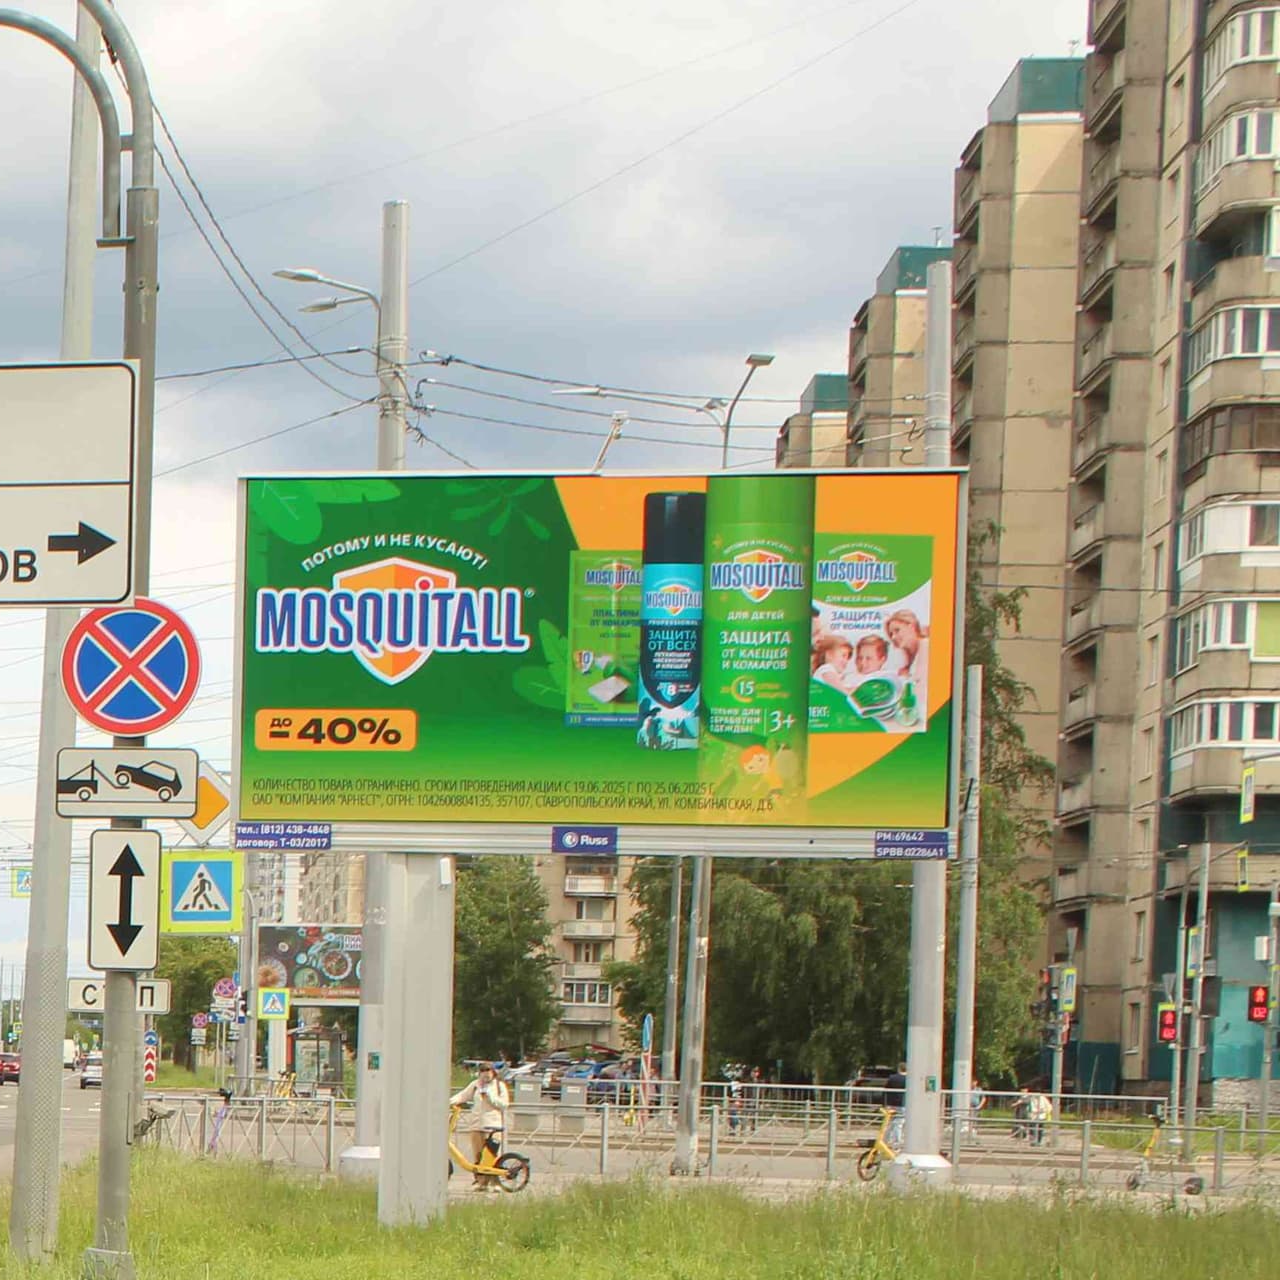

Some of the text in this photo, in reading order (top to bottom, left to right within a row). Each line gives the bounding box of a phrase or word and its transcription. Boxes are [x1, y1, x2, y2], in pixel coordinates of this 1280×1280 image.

[300, 533, 489, 573] ПОТОМУ И НЕ КУСАЮТ!
[831, 610, 882, 622] ЗАЩИТА
[648, 629, 698, 642] ЗАЩИТА
[719, 630, 791, 647] ЗАЩИТА
[648, 640, 697, 651] ОТ ВСЕХ
[739, 680, 754, 695] 15
[769, 710, 795, 732] 3+
[252, 778, 316, 791] КОЛИЧЕСТВО
[318, 779, 354, 791] ТОВАРА
[425, 780, 458, 792] СРОКИ
[460, 780, 525, 793] ПРОВЕДЕНИЯ
[527, 781, 562, 794] АКЦИИ
[636, 782, 652, 794] ПО
[252, 793, 273, 805] ОАО
[535, 795, 626, 809] СТАВРОПОЛЬСКИЙ
[261, 823, 285, 835] (812)
[236, 838, 279, 849] договор:
[579, 834, 609, 846] Russ
